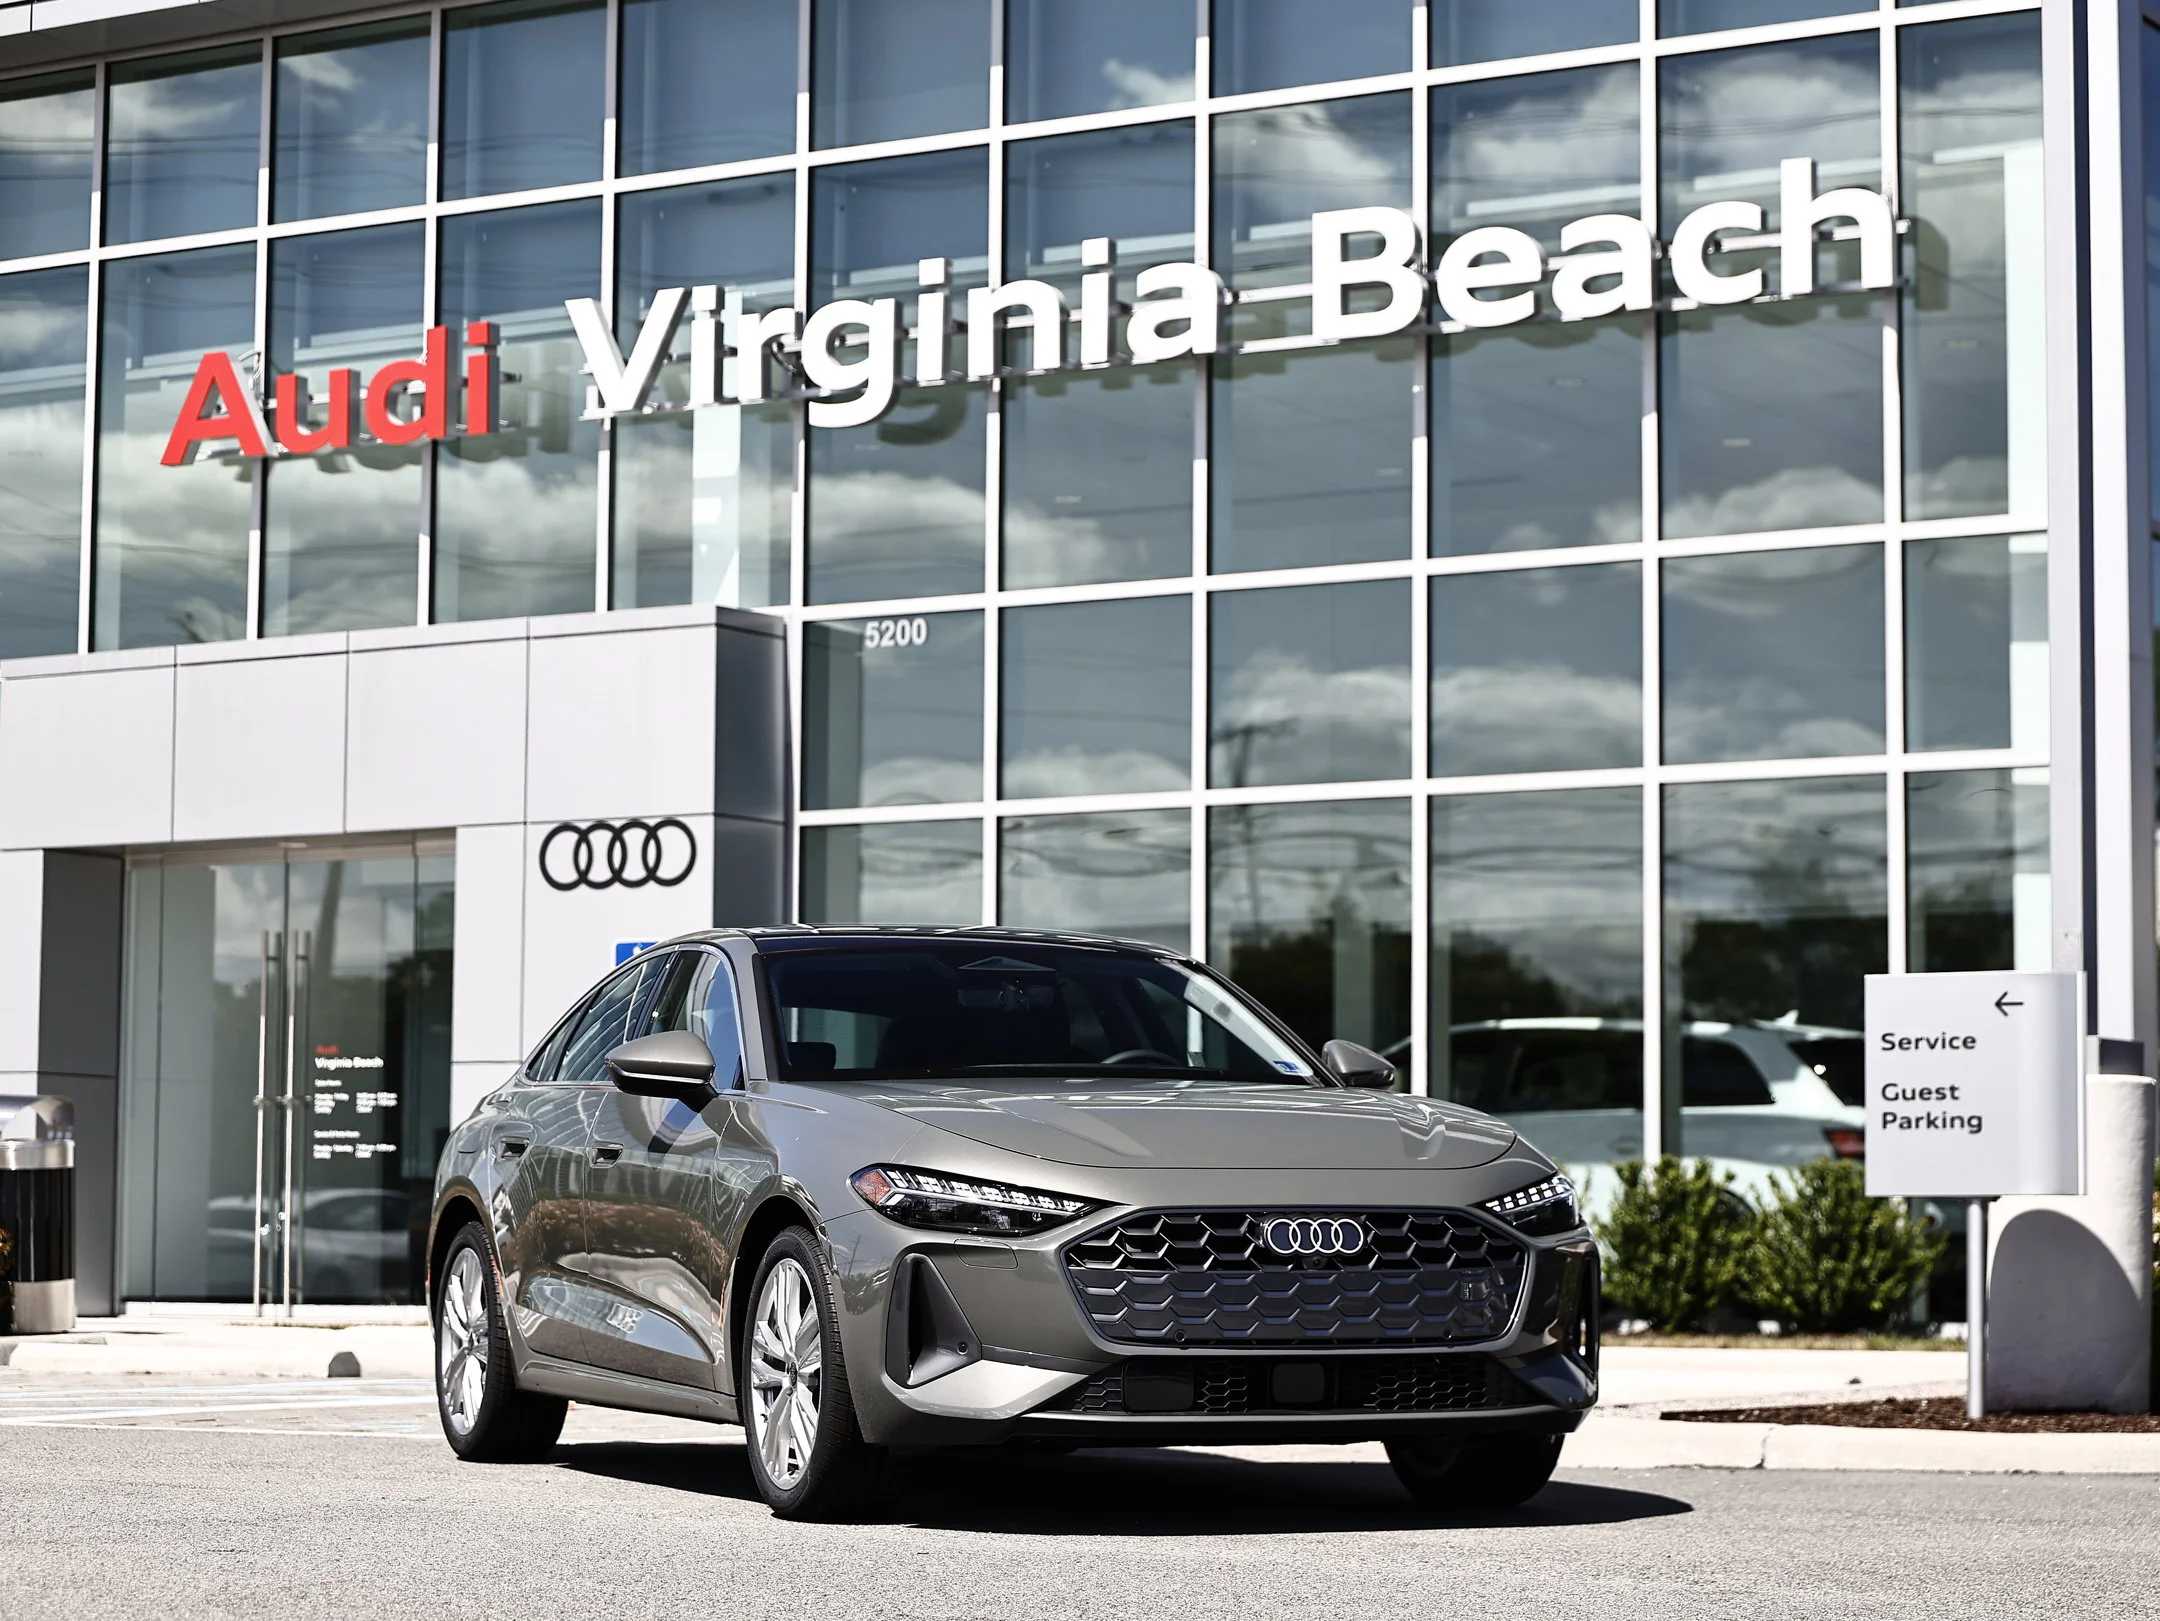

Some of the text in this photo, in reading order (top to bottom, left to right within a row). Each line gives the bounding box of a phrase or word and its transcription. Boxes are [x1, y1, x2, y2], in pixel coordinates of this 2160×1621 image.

[160, 157, 1896, 466] Audi Virginia Beach
[864, 617, 928, 649] 5200
[1881, 1031, 1978, 1052] Service
[1881, 1082, 1960, 1102] Guest
[1881, 1111, 1983, 1134] Parking
